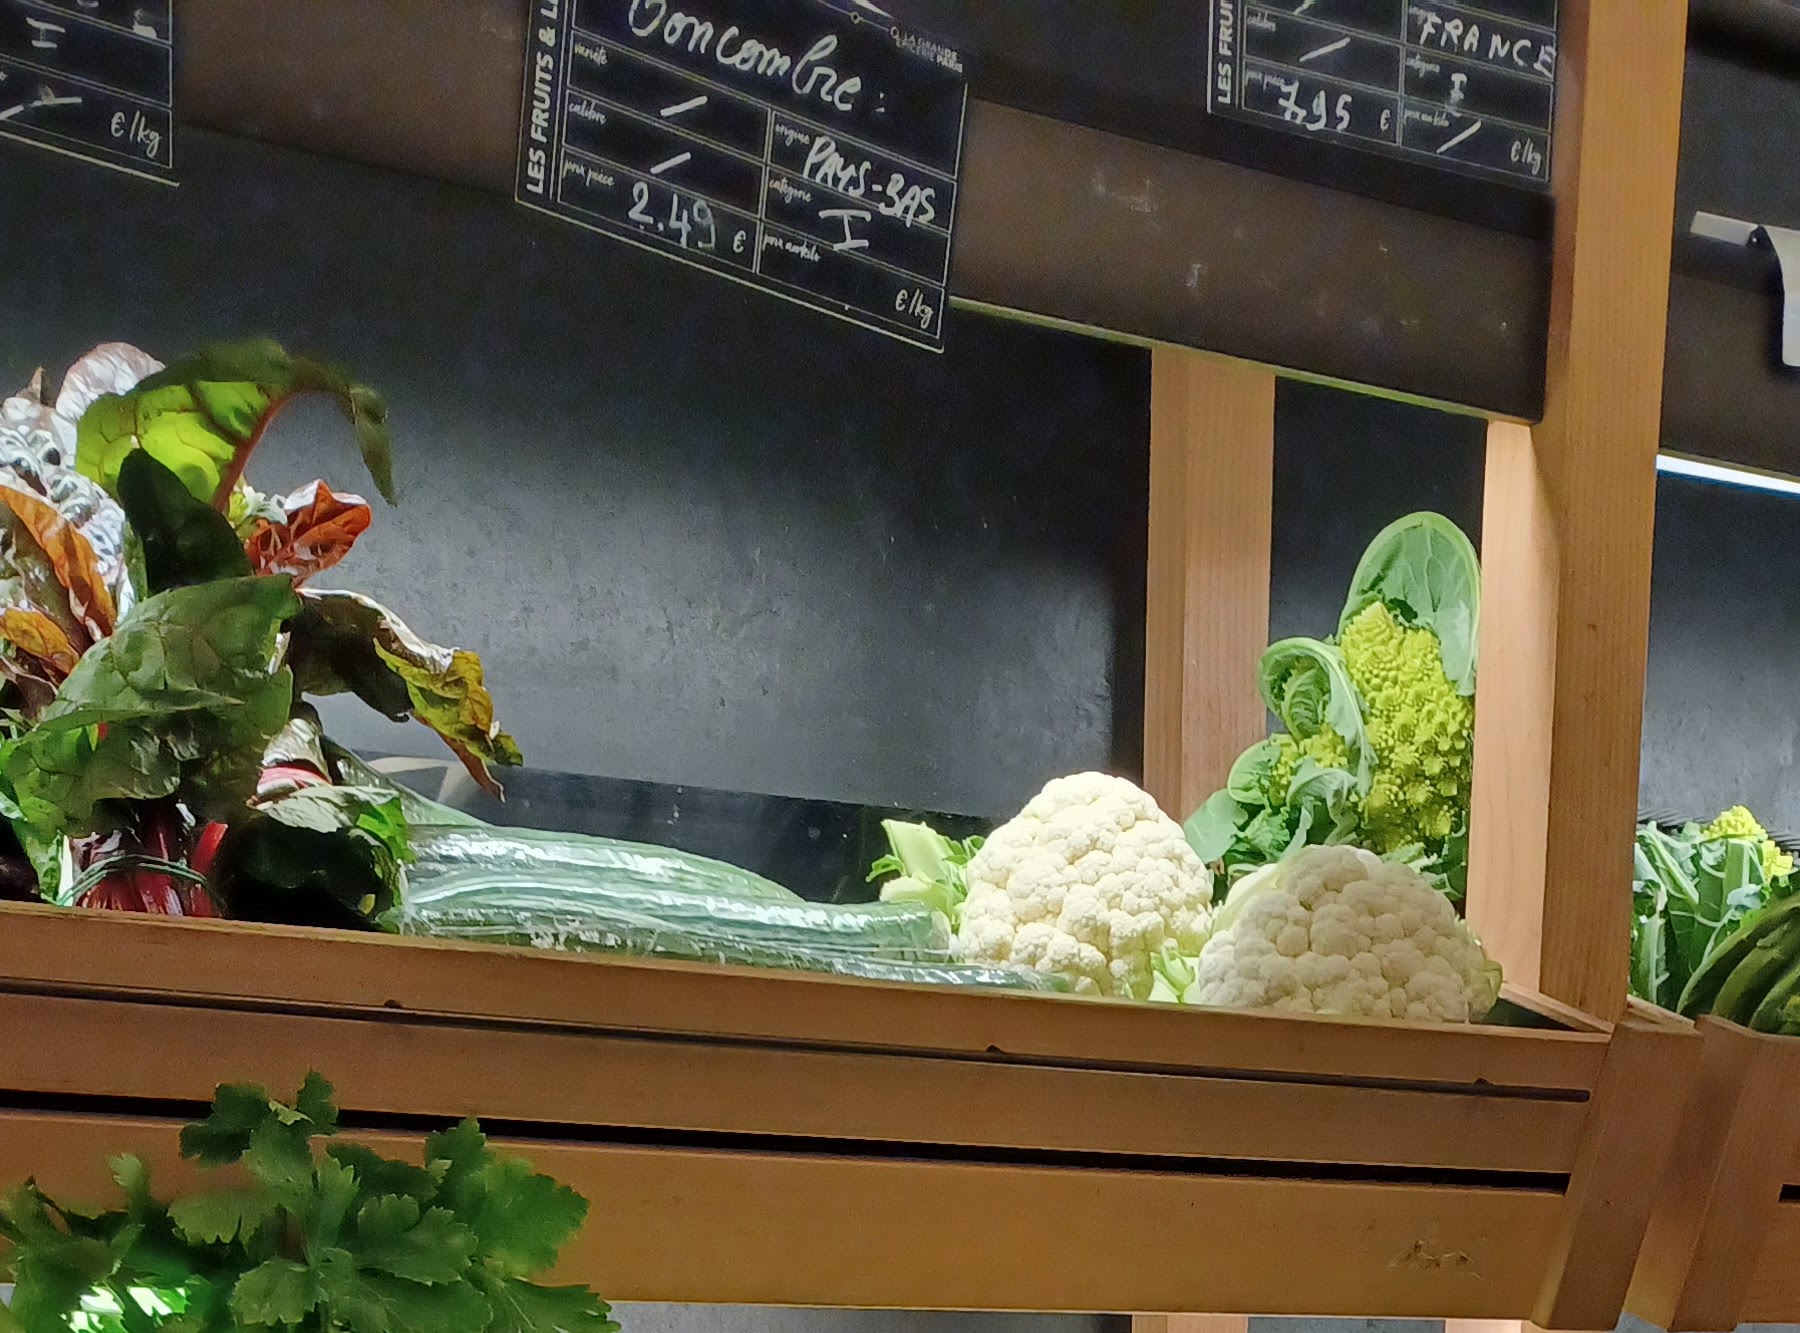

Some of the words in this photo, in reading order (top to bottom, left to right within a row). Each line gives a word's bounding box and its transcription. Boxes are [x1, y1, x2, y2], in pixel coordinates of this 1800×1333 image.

[538, 26, 556, 47] &
[1419, 12, 1556, 79] FRANCE
[531, 51, 554, 143] FRUITS
[1217, 62, 1232, 105] LES
[111, 110, 162, 158] €/kg
[1380, 108, 1392, 132] €
[526, 147, 546, 194] LES
[1510, 137, 1542, 175] €/kg
[803, 135, 936, 228] PAYS-BAS
[733, 230, 747, 253] €
[818, 209, 872, 251] I
[895, 288, 934, 330] €/kg
